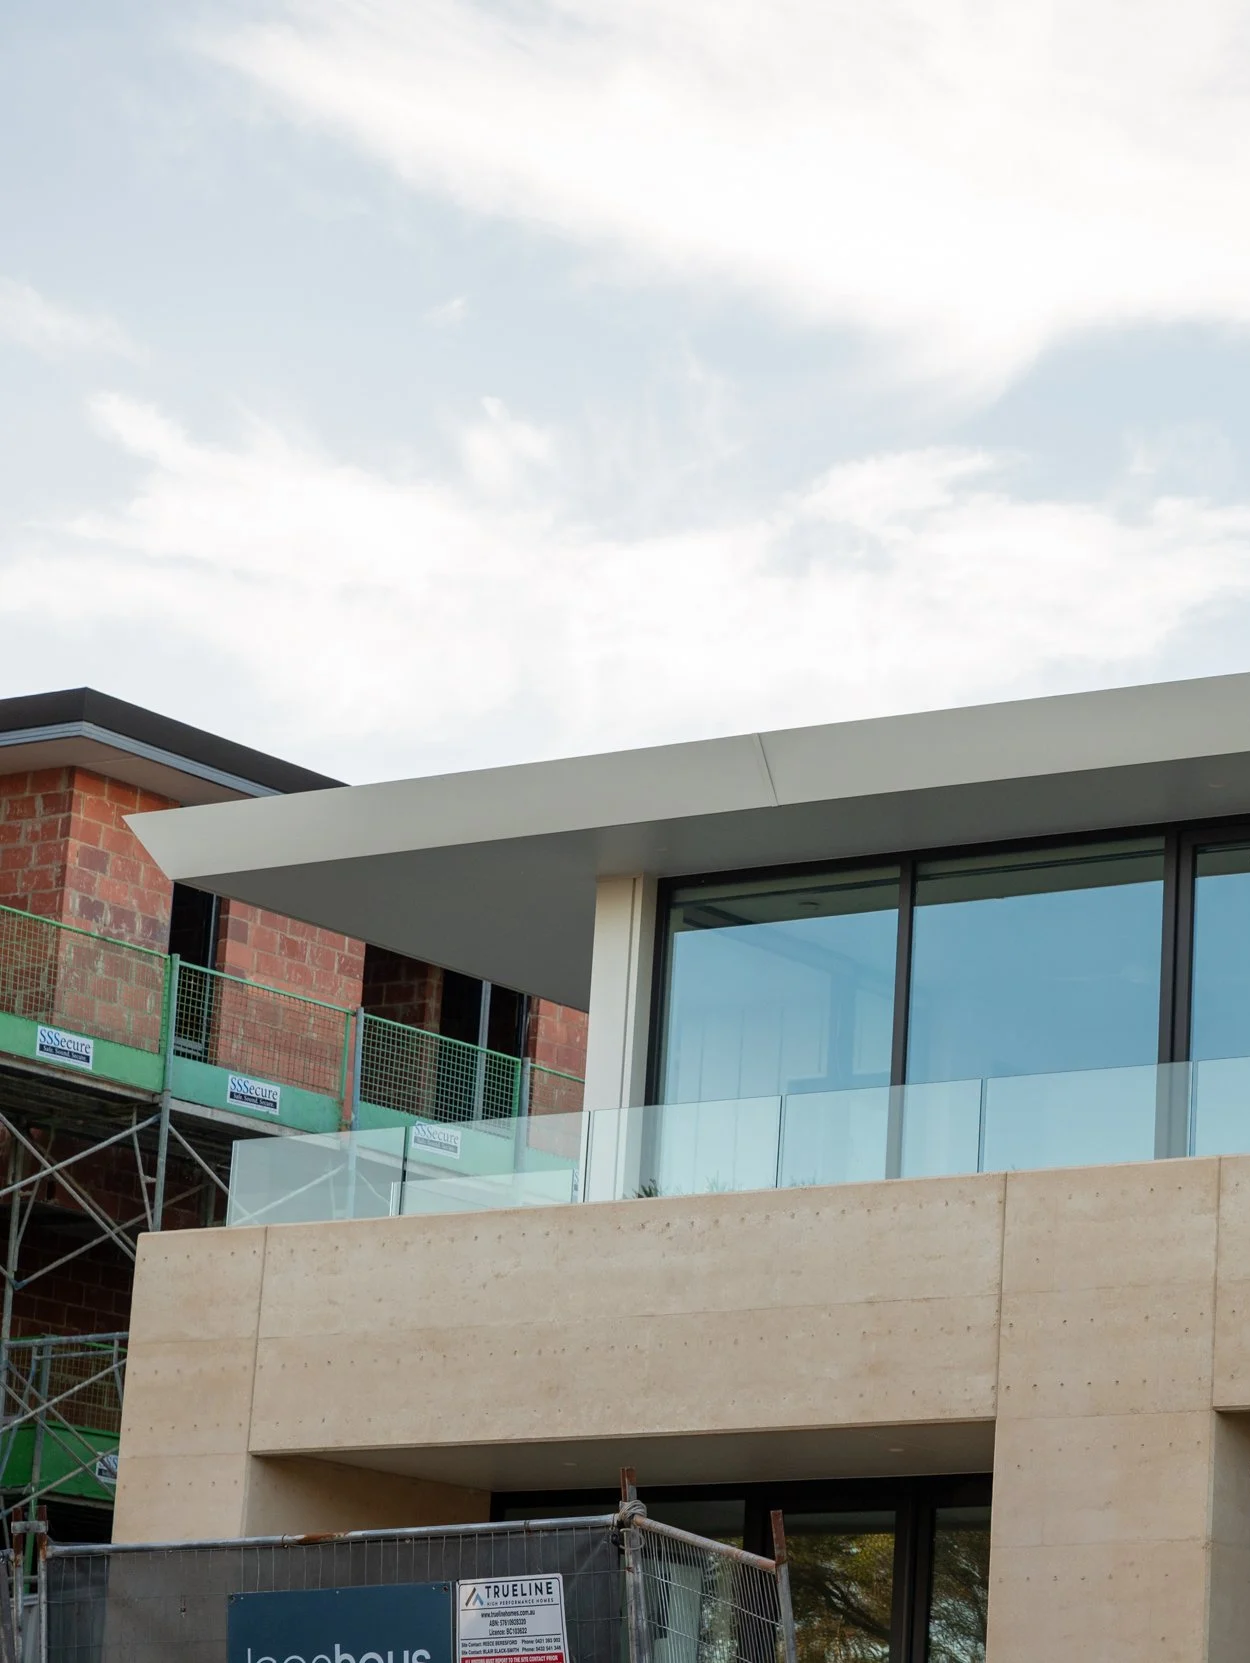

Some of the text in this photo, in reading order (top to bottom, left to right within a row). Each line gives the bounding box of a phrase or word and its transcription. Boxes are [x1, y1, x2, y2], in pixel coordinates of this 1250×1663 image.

[40, 1028, 91, 1054] SSSecure
[230, 1077, 278, 1101] SSSecure
[485, 1581, 553, 1599] TRUELINE
[481, 1610, 536, 1618] www.truelinehomes.com.au
